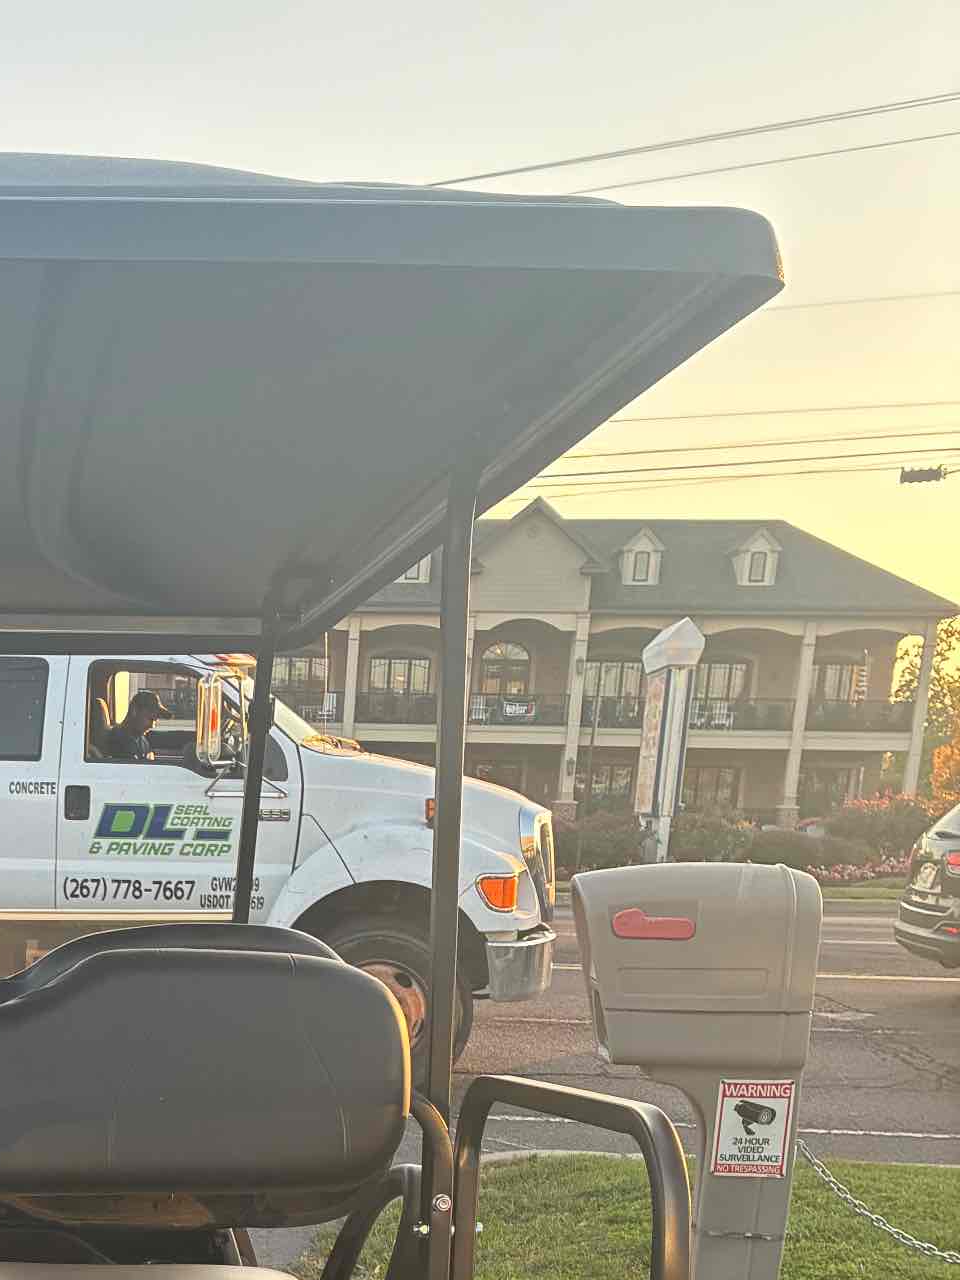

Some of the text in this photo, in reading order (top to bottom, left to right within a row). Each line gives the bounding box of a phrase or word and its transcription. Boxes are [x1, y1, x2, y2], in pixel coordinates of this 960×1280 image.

[9, 781, 56, 795] CONCRETE
[174, 805, 210, 816] SEAL
[94, 803, 187, 840] DL
[170, 817, 233, 828] COATING
[89, 842, 232, 857] & PAVING CORP
[63, 877, 196, 901] (267) 778-7667
[200, 894, 231, 909] USDOT
[724, 1084, 791, 1097] WARNING
[732, 1137, 771, 1146] 24 HOUR
[737, 1146, 765, 1154] VIDEO
[719, 1153, 781, 1163] SURVEILLANCE
